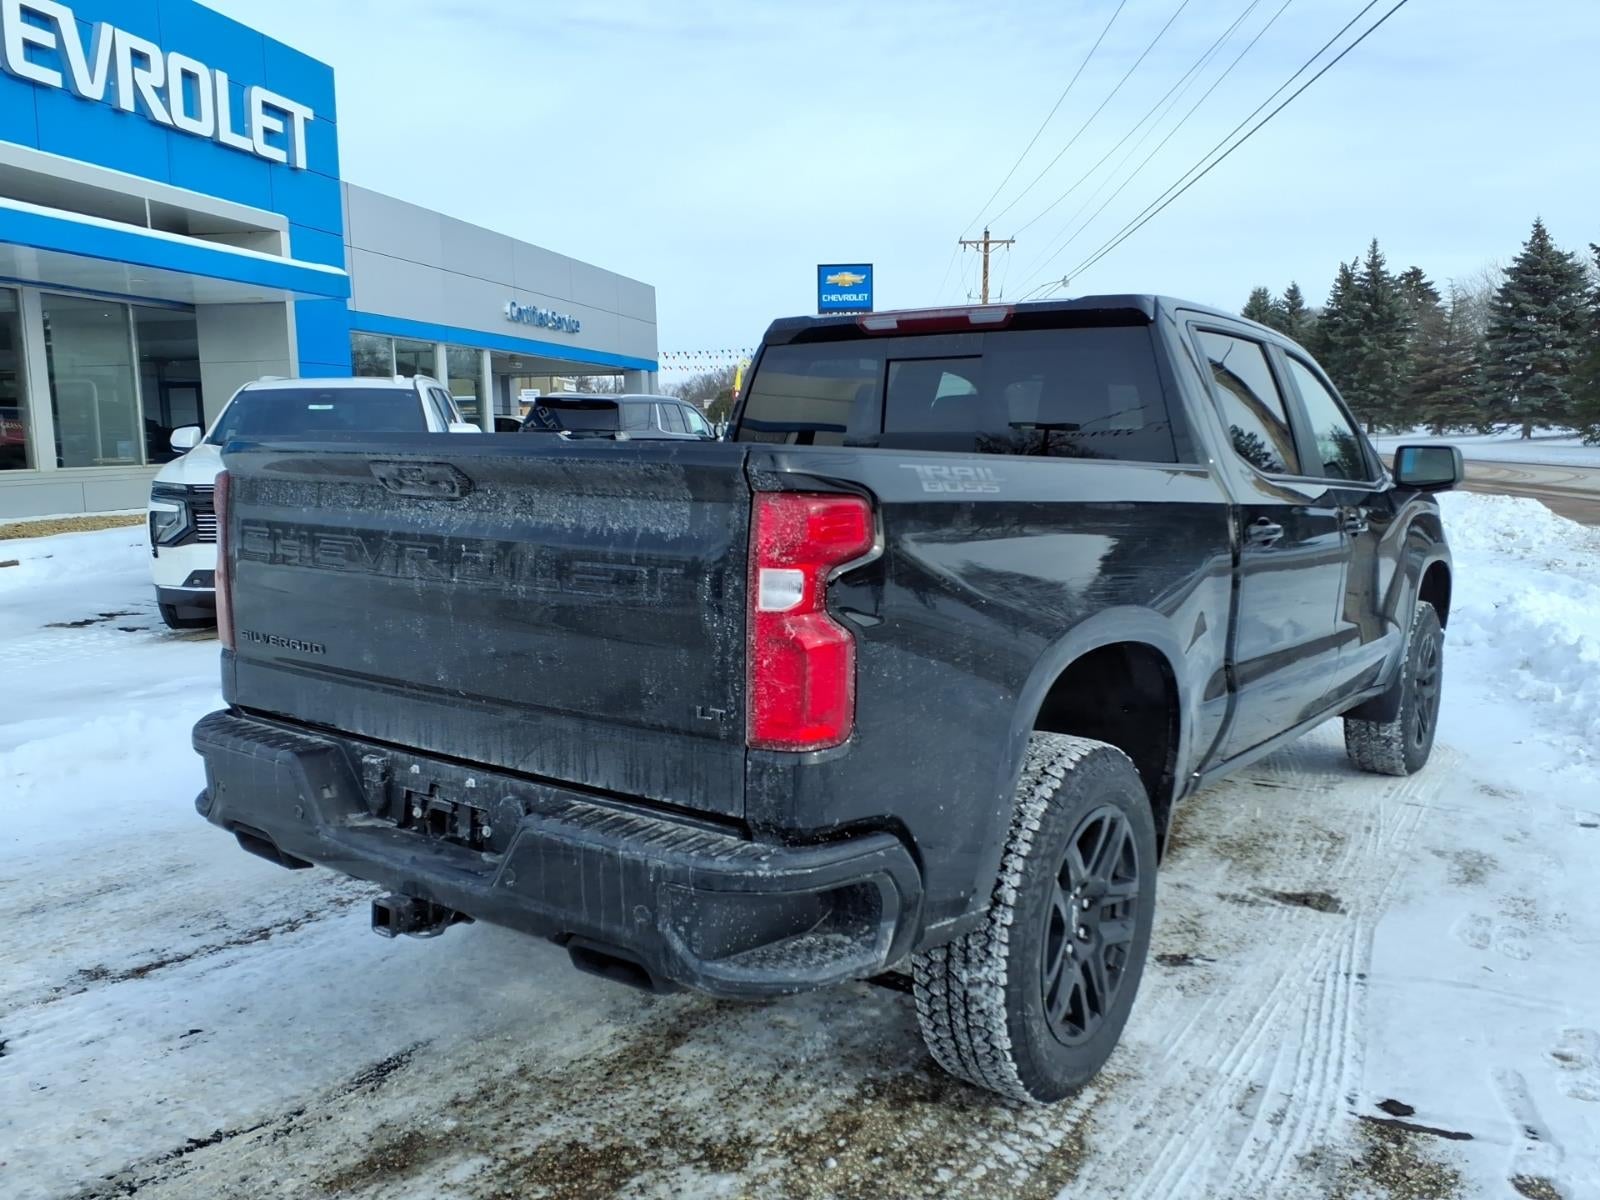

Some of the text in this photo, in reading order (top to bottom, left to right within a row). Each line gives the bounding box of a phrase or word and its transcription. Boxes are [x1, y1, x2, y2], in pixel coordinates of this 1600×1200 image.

[822, 293, 868, 302] CHEVROLET
[505, 300, 581, 334] Certified Service
[898, 463, 1005, 481] TRAIL
[921, 480, 1001, 493] BOSS
[240, 629, 327, 655] SILVERADO
[696, 704, 727, 721] LT
